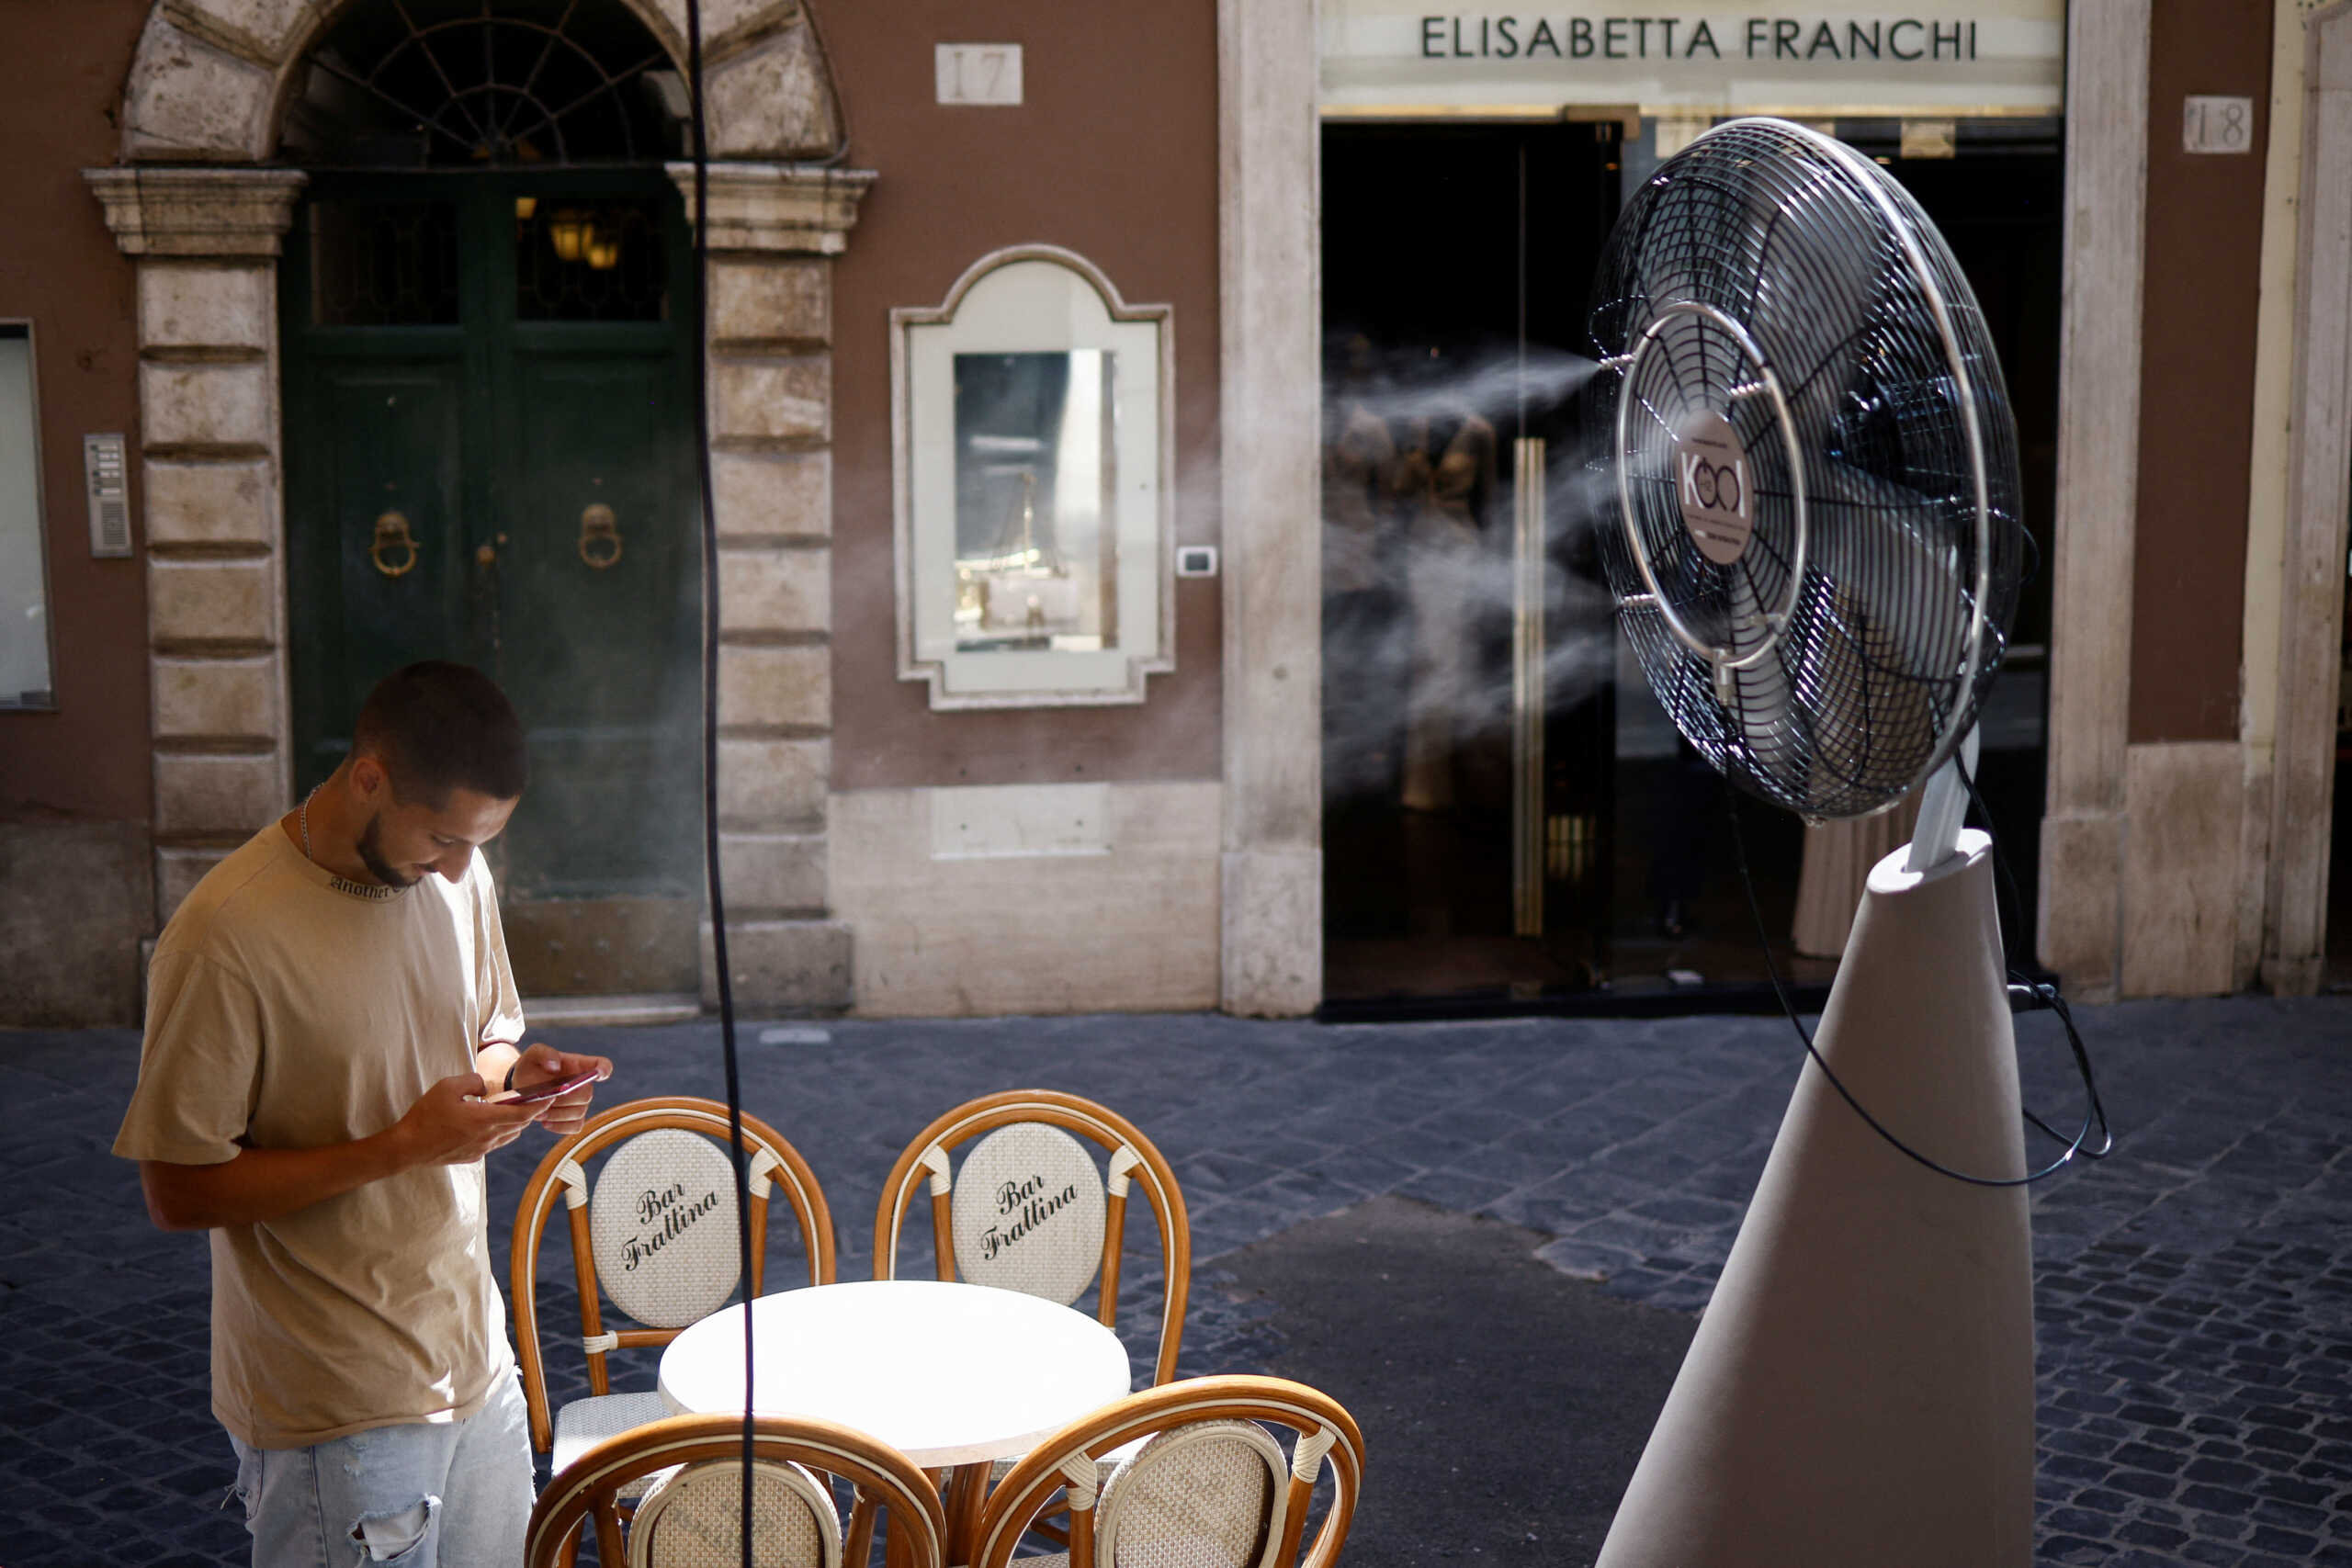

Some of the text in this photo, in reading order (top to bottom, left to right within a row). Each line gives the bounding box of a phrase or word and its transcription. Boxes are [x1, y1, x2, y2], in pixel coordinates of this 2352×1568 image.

[1420, 16, 1976, 61] ELISABETTA FRANCHI
[953, 51, 1006, 98] 17
[2197, 102, 2245, 146] 18
[636, 1182, 684, 1225] Bar
[995, 1174, 1045, 1215] Bar
